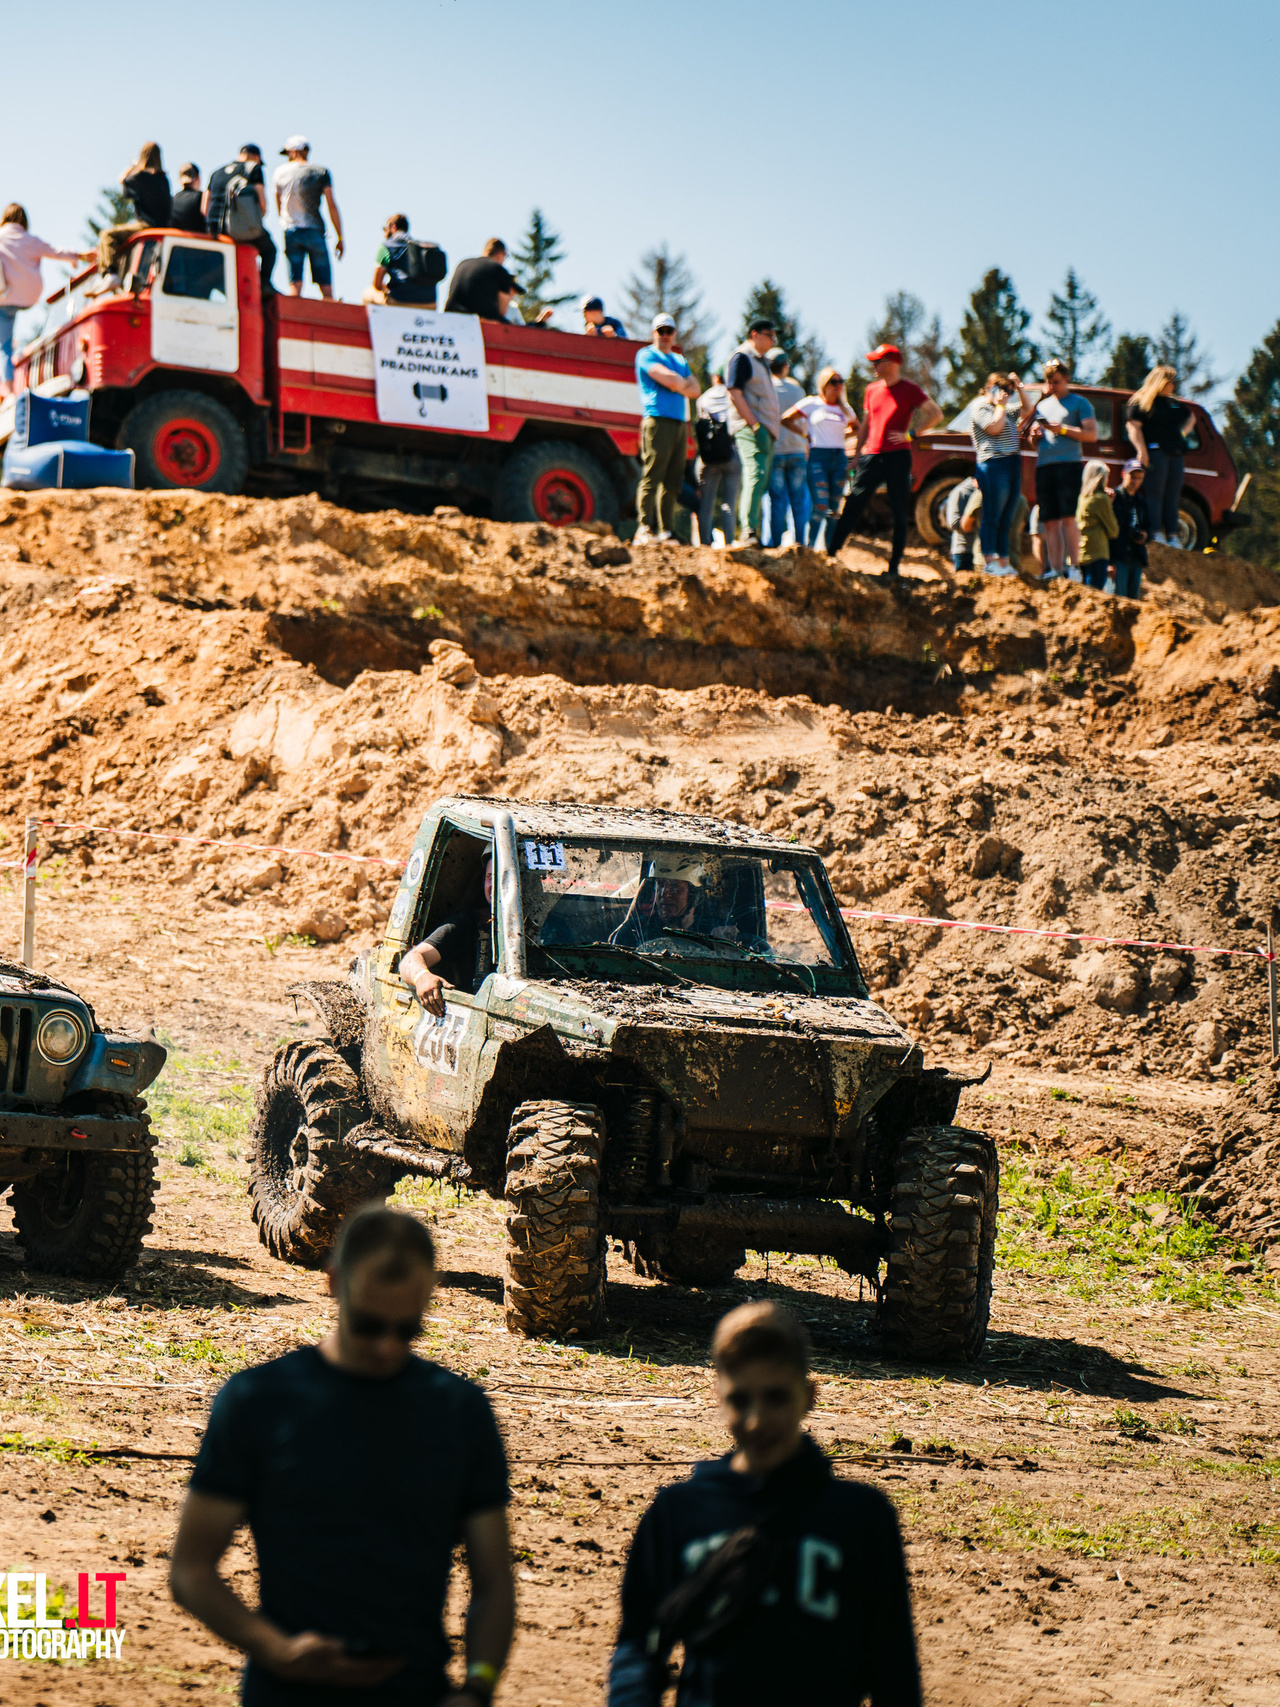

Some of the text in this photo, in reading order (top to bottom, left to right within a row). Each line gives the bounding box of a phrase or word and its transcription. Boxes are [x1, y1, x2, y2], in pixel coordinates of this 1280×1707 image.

[397, 346, 461, 361] PAGALBA
[381, 359, 479, 379] PRADINUKAMS
[532, 844, 562, 866] 11
